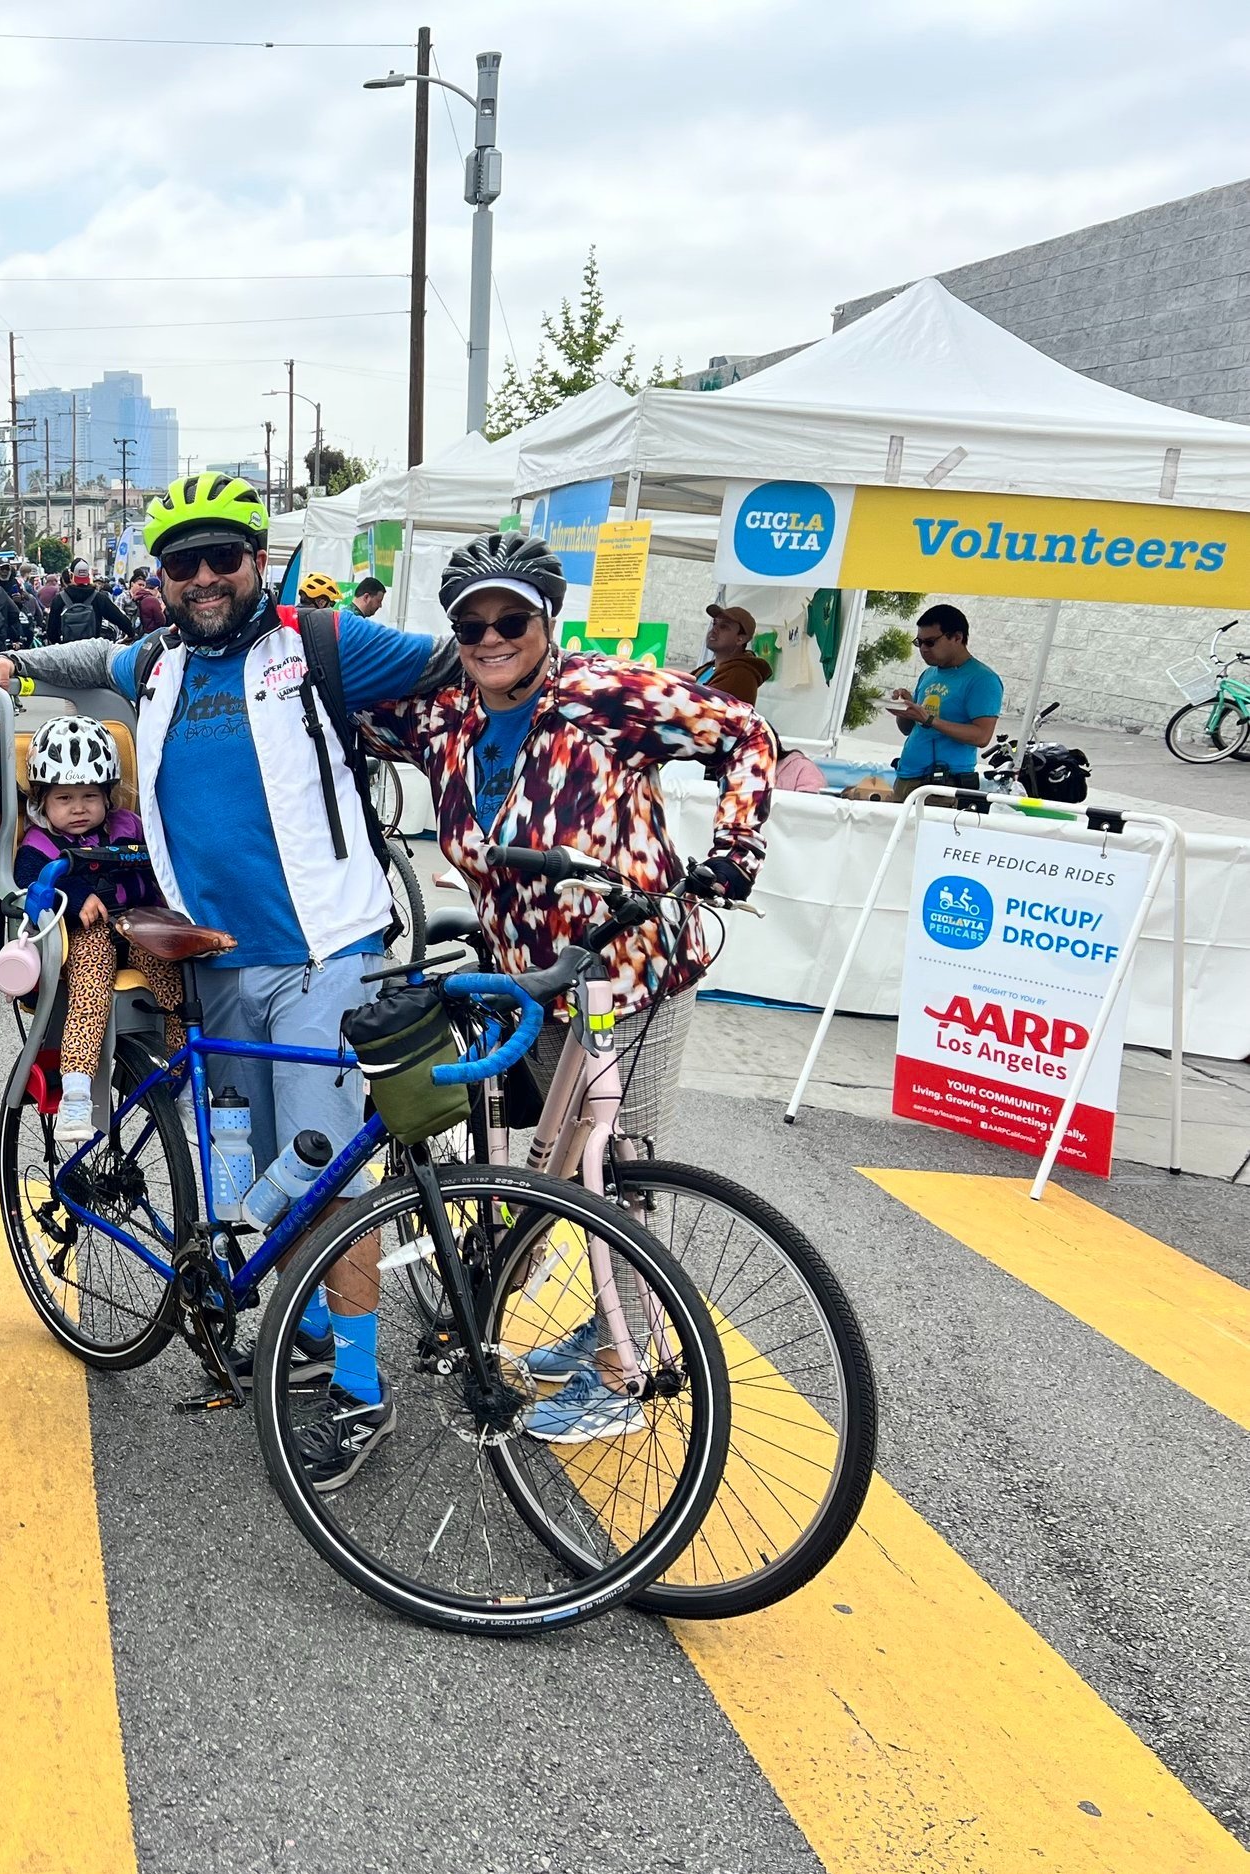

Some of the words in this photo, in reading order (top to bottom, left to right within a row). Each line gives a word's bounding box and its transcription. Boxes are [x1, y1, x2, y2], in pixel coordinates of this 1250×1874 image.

[745, 510, 824, 532] CICLA
[771, 531, 821, 551] VIA
[912, 517, 1227, 572] Volunteers
[263, 655, 303, 677] OPERATION
[65, 769, 86, 781] Giro
[943, 847, 982, 865] FREE
[987, 854, 1059, 877] PEDICAB
[1064, 867, 1116, 887] RIDES
[930, 912, 985, 931] CICLAVIA
[1006, 898, 1103, 932] PICKUP/
[929, 923, 984, 942] PEDICABS
[1003, 925, 1119, 963] DROPOFF
[972, 983, 1007, 998] BROUGHT
[1008, 991, 1019, 999] TO
[1020, 993, 1036, 1004] YOU
[1037, 998, 1047, 1006] BY
[924, 995, 1090, 1058] AARP
[936, 1030, 972, 1055] Los
[977, 1042, 1068, 1081] Angeles
[912, 1083, 944, 1101] Living.
[945, 1093, 989, 1114] Growing.
[991, 1105, 1047, 1132] Connecting
[1049, 1122, 1088, 1142] Lcally.
[946, 1079, 977, 1096] YOUR
[978, 1087, 1052, 1117] COMMUNITY:
[313, 1133, 371, 1198] CYCLES
[579, 1581, 631, 1612] SCHWALBE
[490, 1617, 542, 1626] MARATHON
